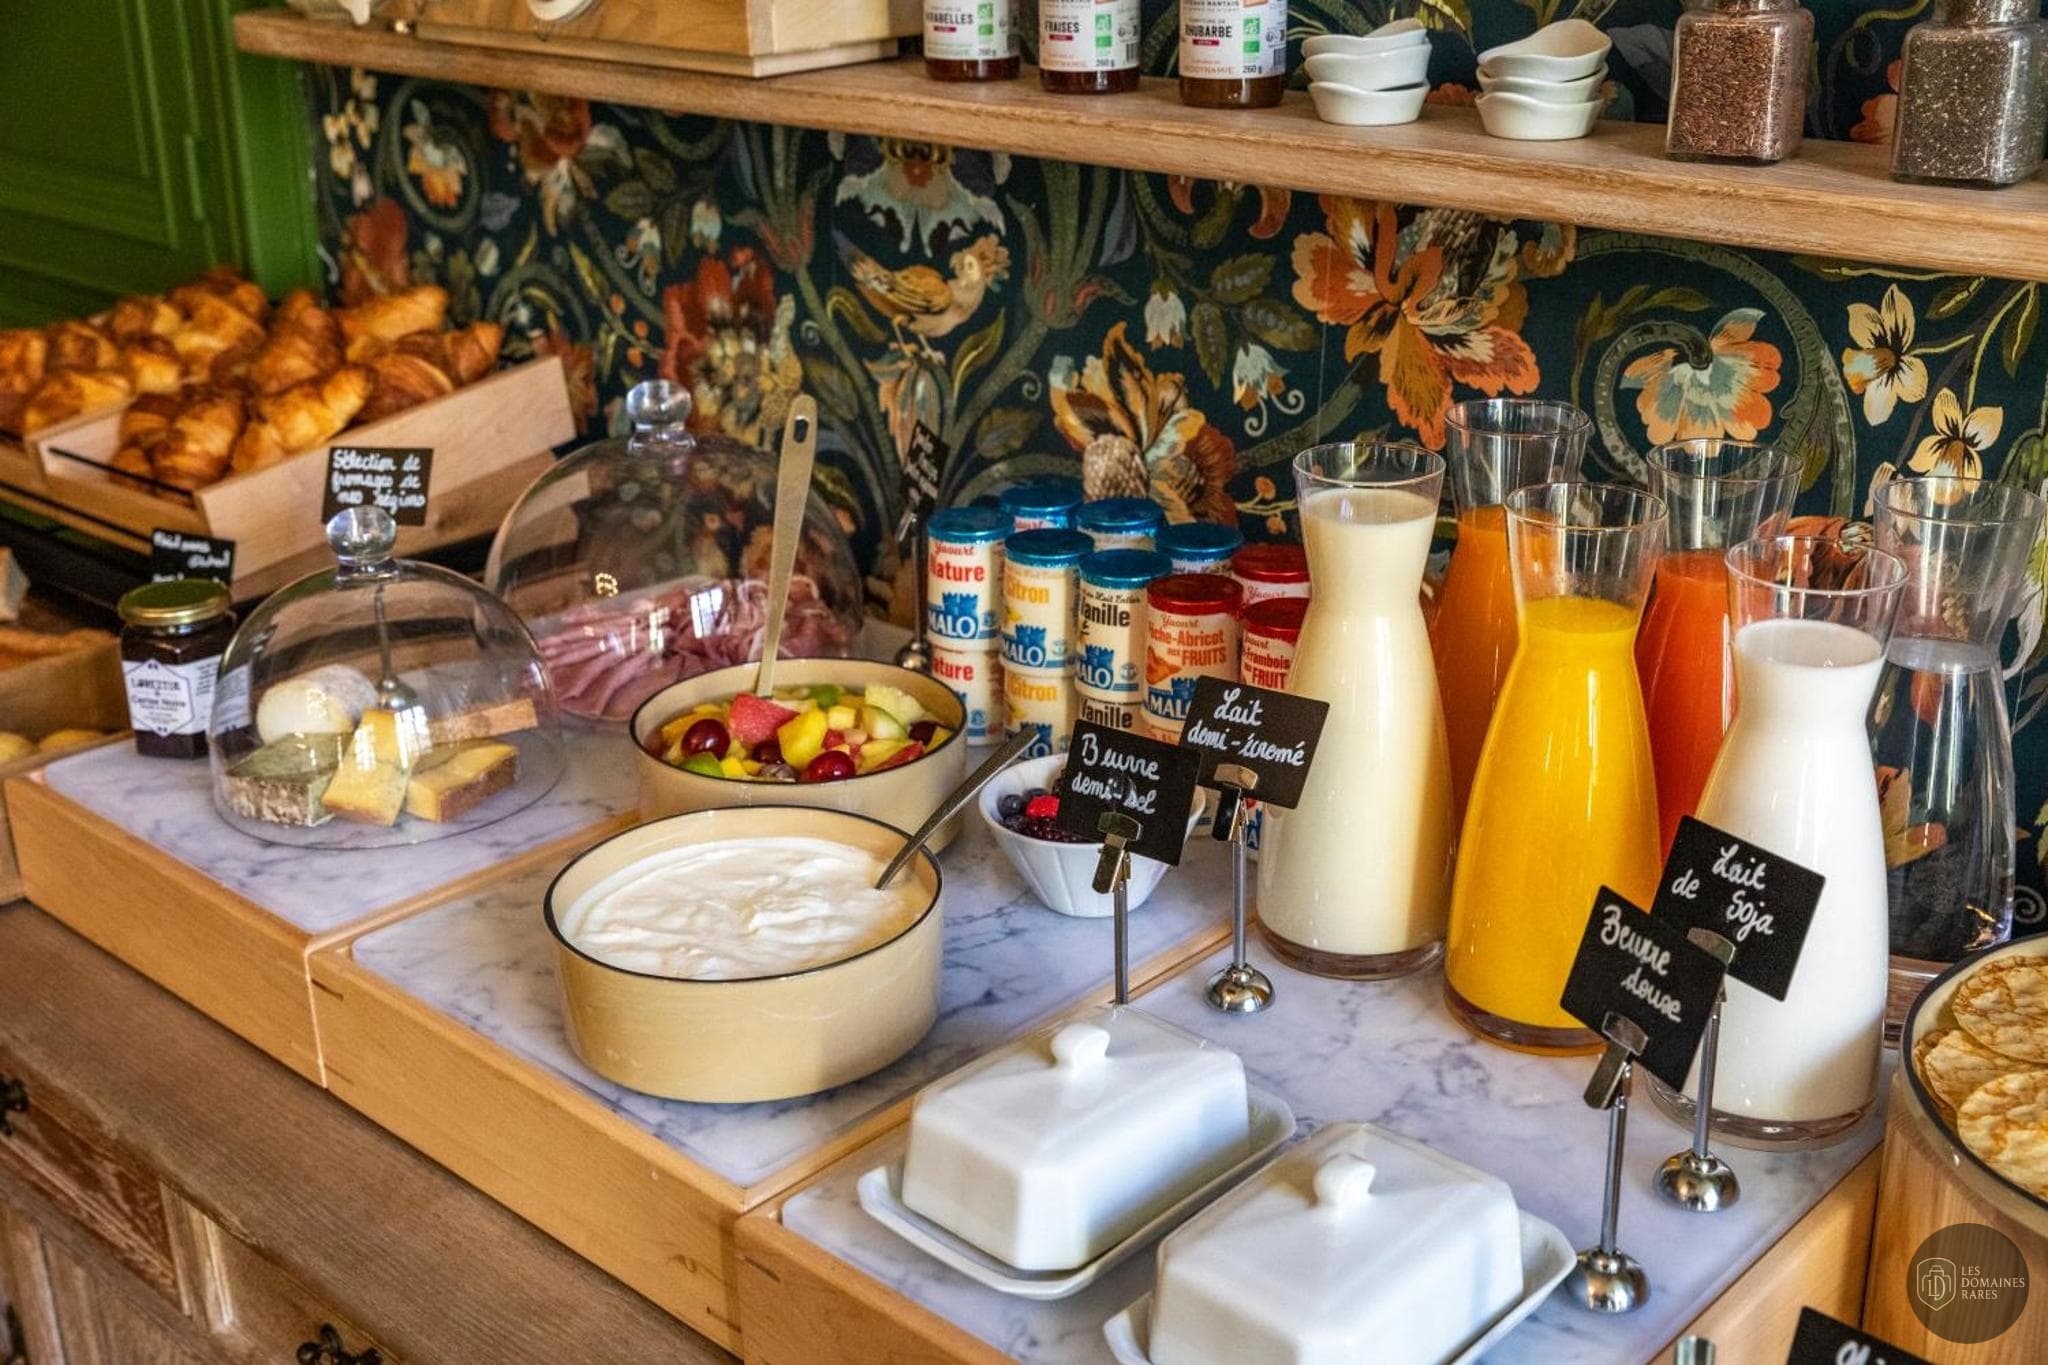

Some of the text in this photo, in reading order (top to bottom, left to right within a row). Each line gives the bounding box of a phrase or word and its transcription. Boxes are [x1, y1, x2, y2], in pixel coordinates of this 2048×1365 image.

[926, 12, 974, 24] RABELLES
[1045, 21, 1080, 33] FRAISES
[1242, 65, 1257, 73] 260
[402, 454, 421, 471] de
[399, 474, 421, 488] de
[934, 542, 975, 556] Yaourt
[1161, 613, 1199, 629] Yaourt
[1246, 637, 1269, 649] aourt
[1182, 646, 1227, 667] FRUITS
[932, 654, 975, 681] ature
[1213, 687, 1264, 726] Lait
[1082, 732, 1160, 780] Beurre
[1712, 844, 1767, 890] Lait
[1671, 868, 1774, 942] de Soja
[1600, 904, 1671, 976] Beurre
